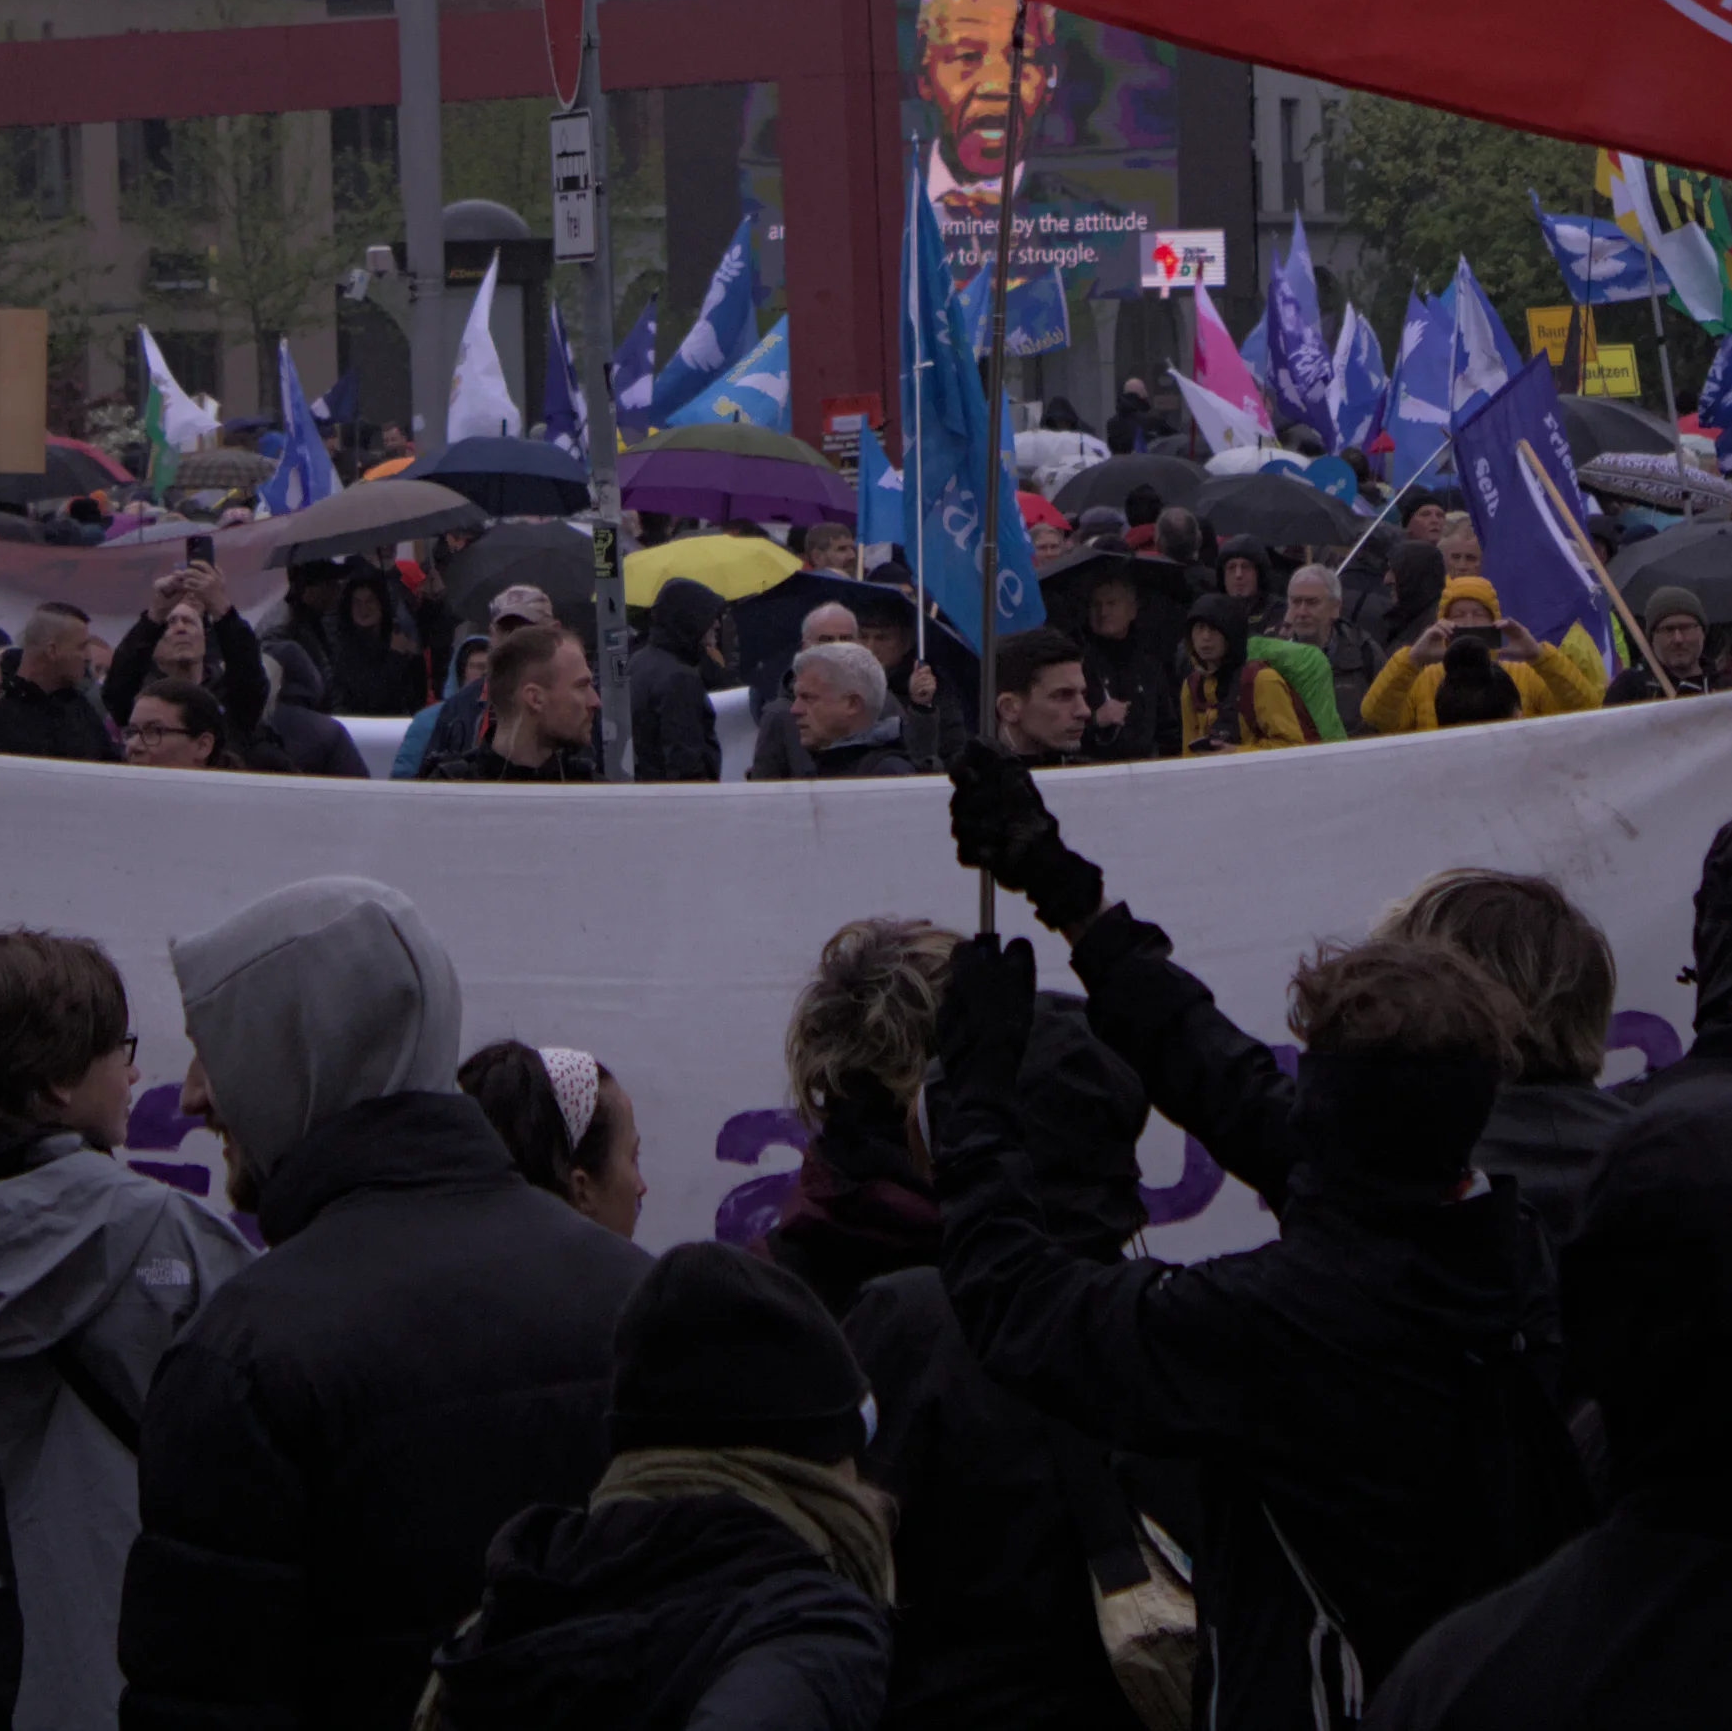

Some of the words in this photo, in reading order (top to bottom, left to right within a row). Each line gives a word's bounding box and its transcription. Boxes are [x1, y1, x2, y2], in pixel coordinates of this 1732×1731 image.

[565, 208, 581, 240] frei
[1011, 212, 1036, 239] by
[1039, 209, 1071, 233] the
[1074, 211, 1148, 232] attitude
[957, 247, 978, 266] to
[1018, 244, 1099, 268] struggle.
[1584, 364, 1630, 380] autzen
[136, 1267, 172, 1277] NORTH
[145, 1276, 173, 1286] FACE
